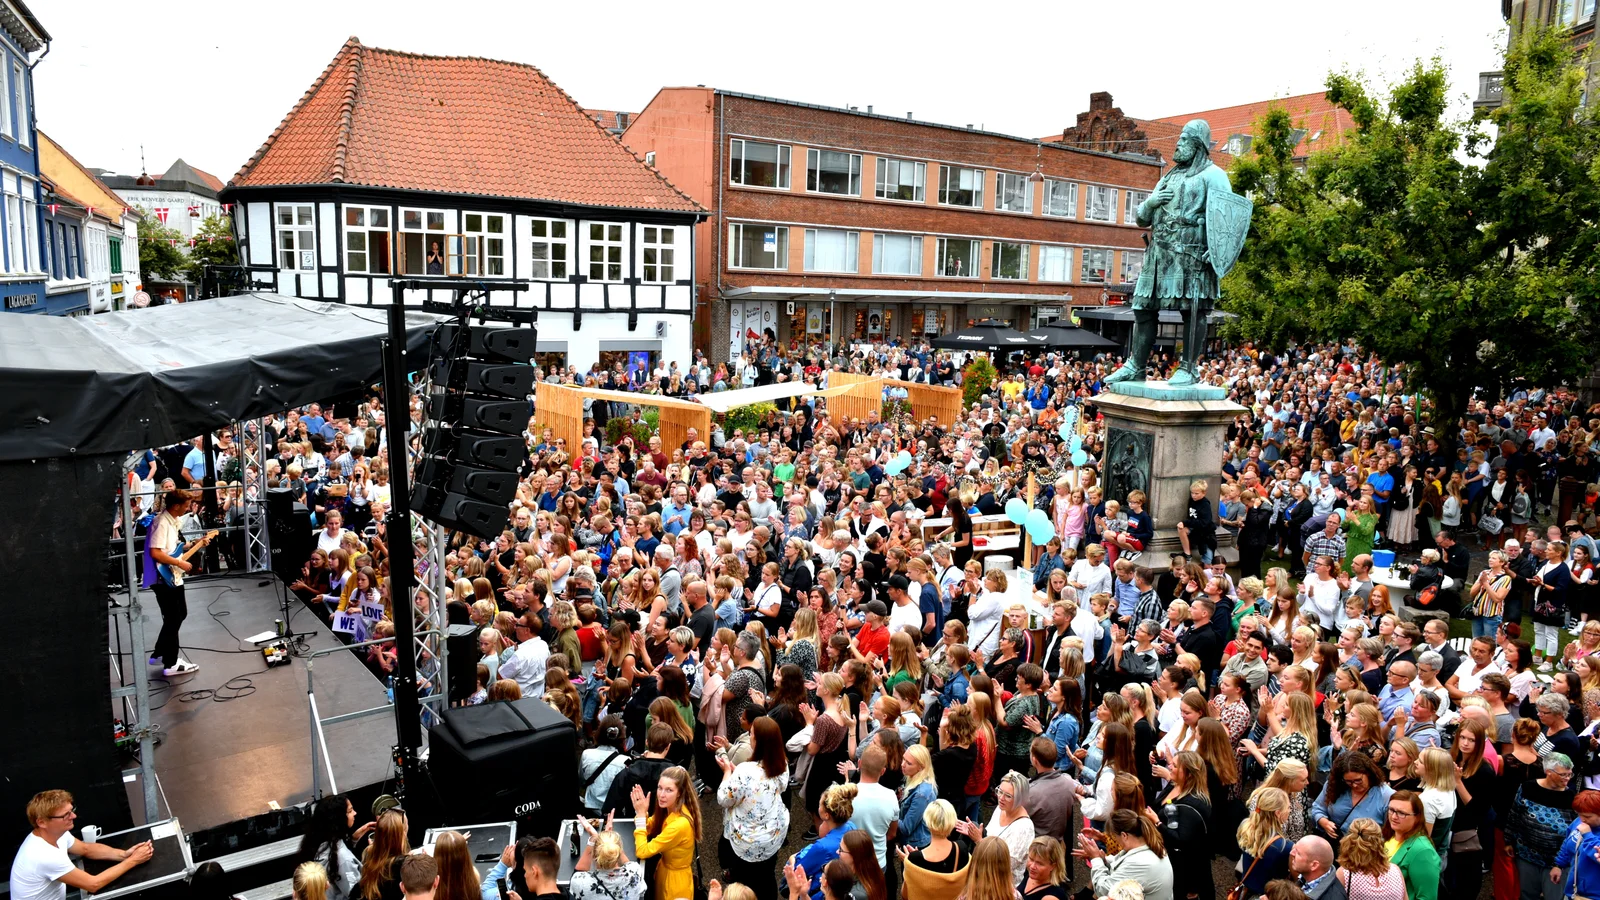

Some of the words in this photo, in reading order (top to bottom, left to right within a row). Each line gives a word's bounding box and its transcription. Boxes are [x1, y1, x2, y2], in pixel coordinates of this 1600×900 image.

[361, 605, 383, 620] LOVE
[340, 616, 355, 631] WE
[514, 800, 541, 815] CODA
